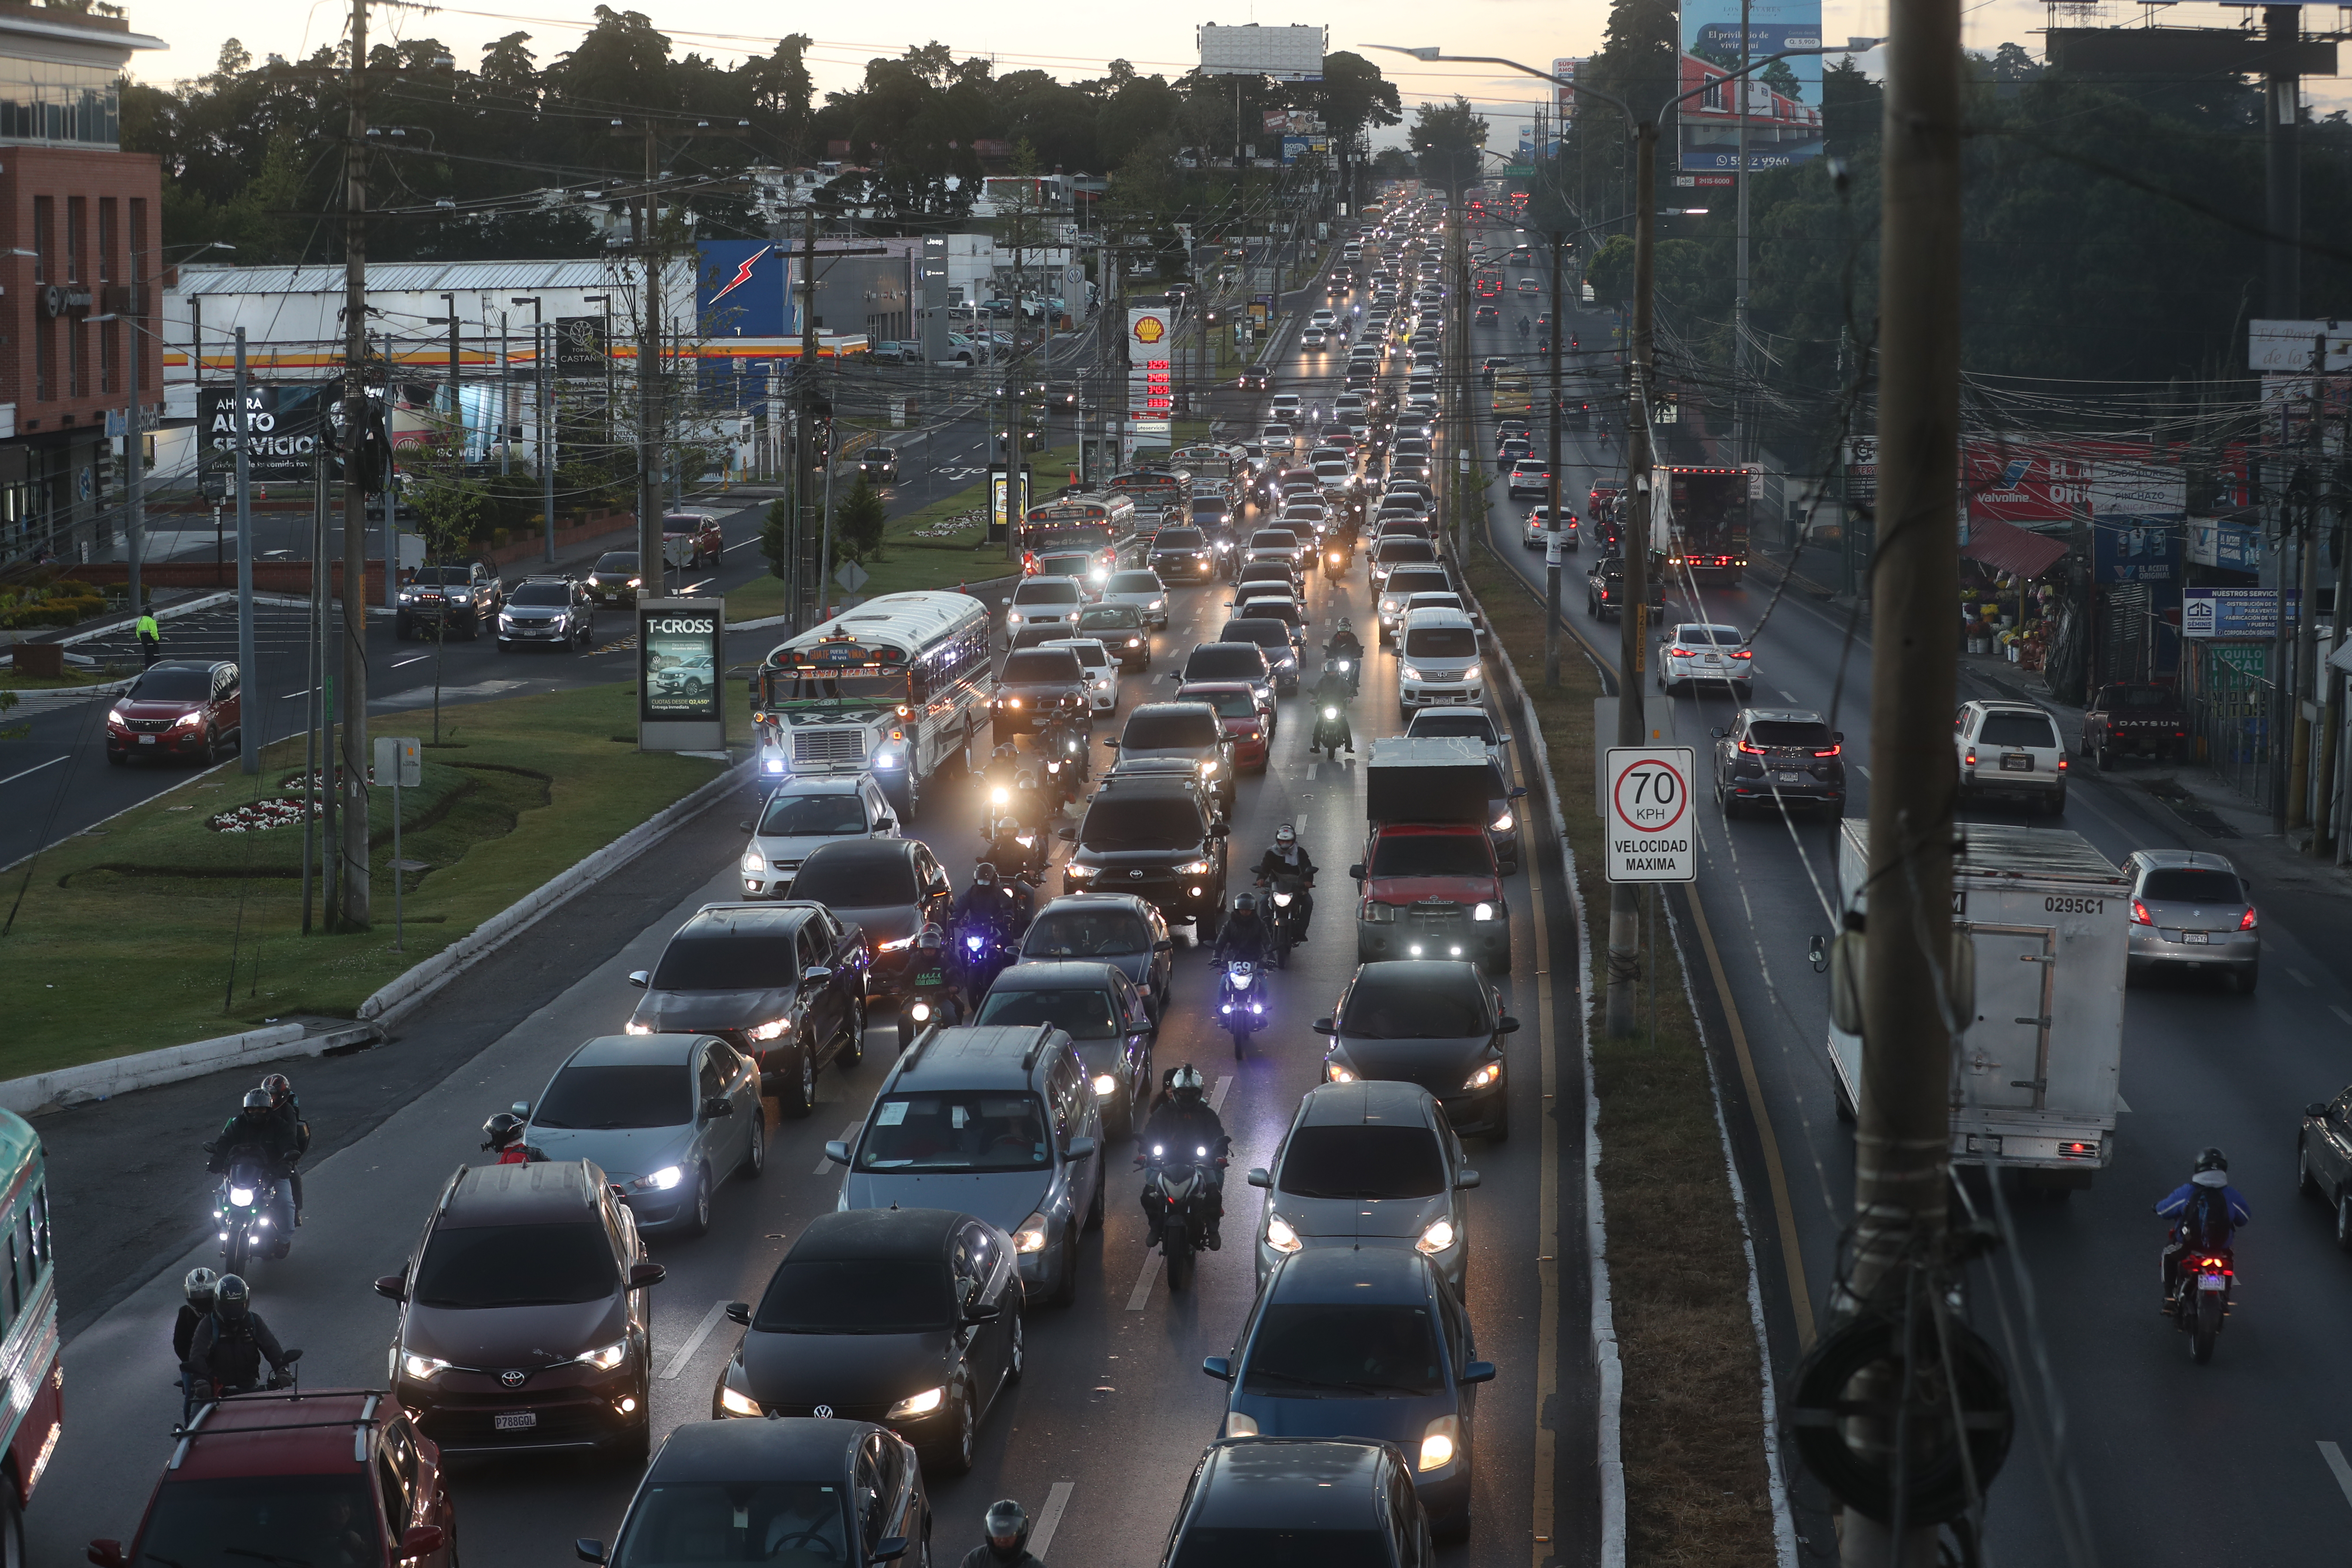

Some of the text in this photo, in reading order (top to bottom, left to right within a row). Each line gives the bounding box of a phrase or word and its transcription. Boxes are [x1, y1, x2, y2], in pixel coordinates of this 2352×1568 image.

[1719, 31, 1758, 40] privilio
[216, 397, 263, 410] AHRA
[1977, 493, 2030, 503] Valvoline
[2115, 492, 2164, 500] PINCHAZO
[2139, 572, 2170, 580] ORIGINAL
[646, 619, 714, 634] T-CROSS
[810, 649, 830, 660] GUATE
[1630, 772, 1674, 804] 70
[1636, 808, 1665, 820] KPH
[1615, 840, 1687, 853] VELOCIDAD
[1626, 858, 1676, 870] MAXIMA
[2045, 897, 2104, 914] 0295C1
[1233, 961, 1251, 974] 69
[496, 1415, 536, 1427] P788GQL
